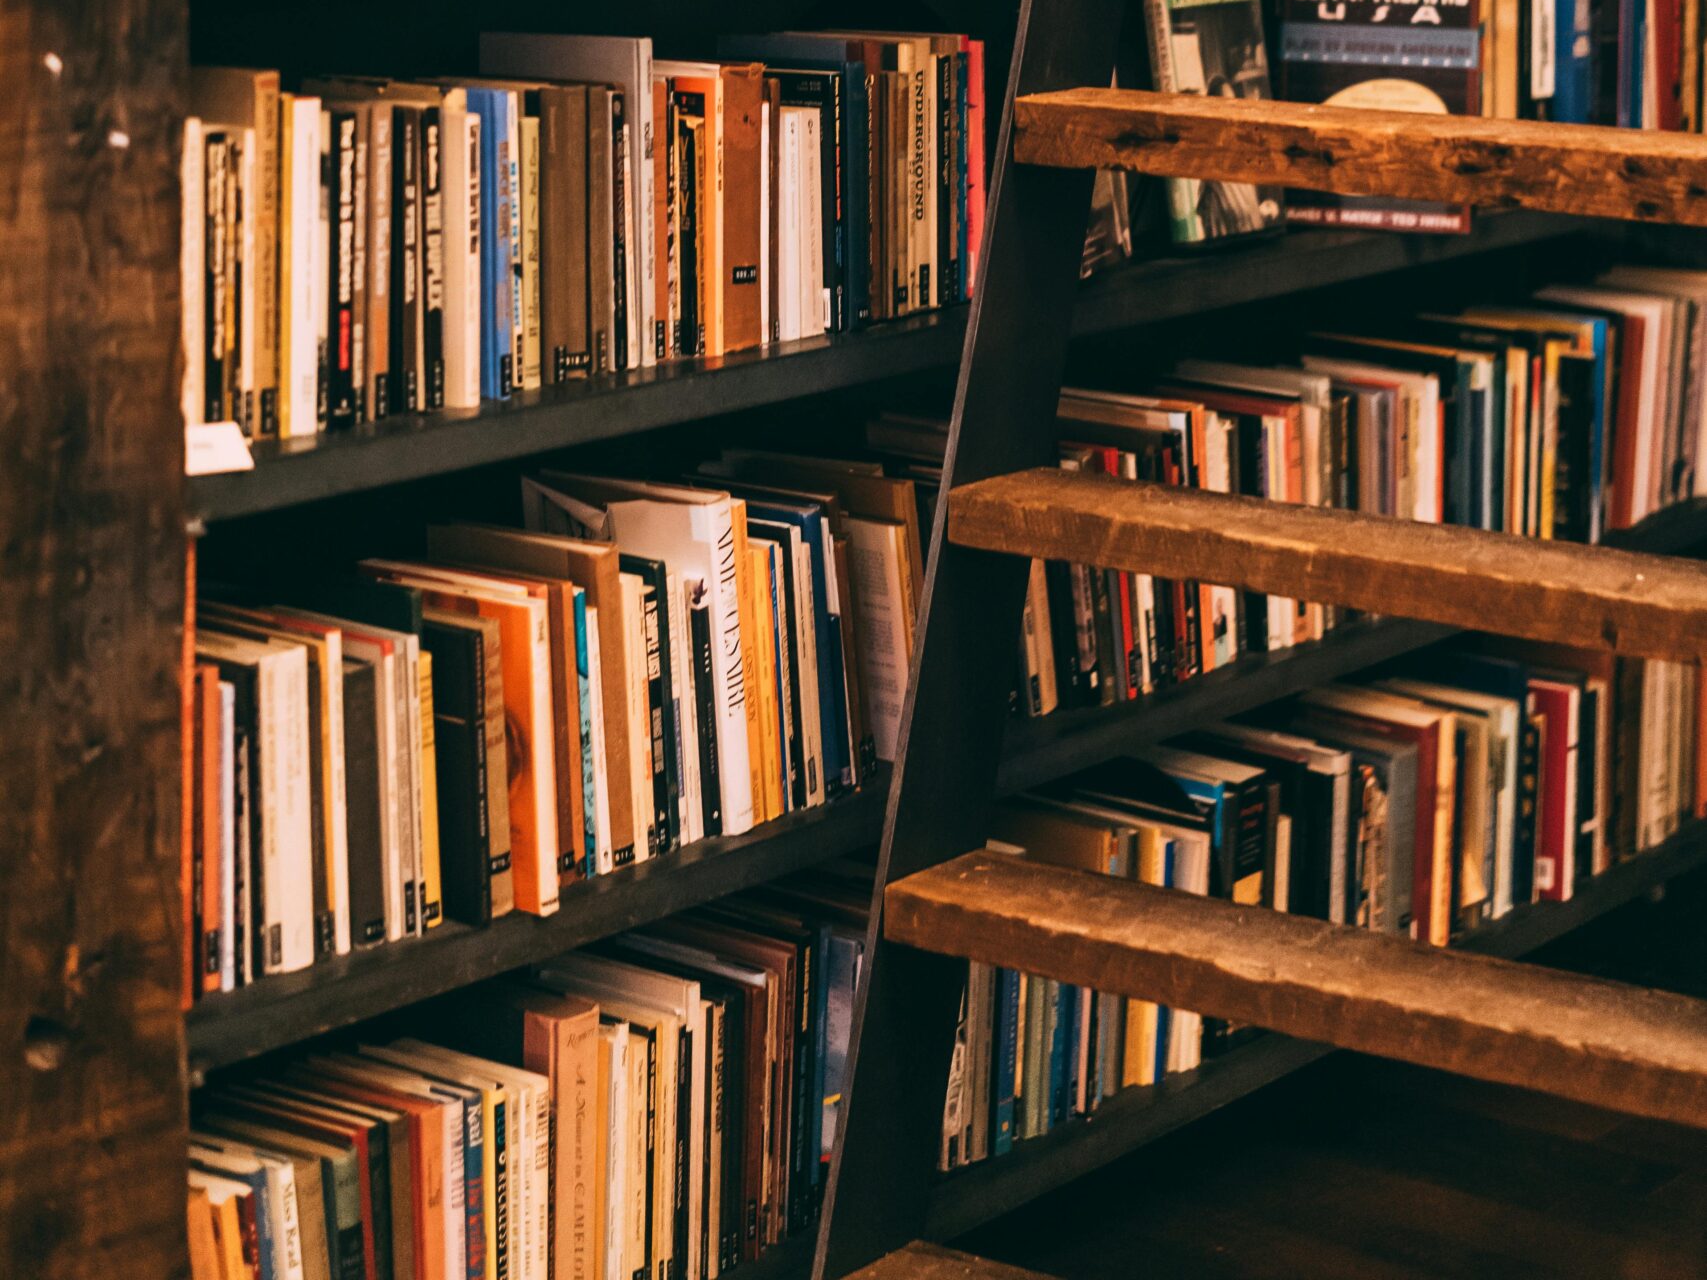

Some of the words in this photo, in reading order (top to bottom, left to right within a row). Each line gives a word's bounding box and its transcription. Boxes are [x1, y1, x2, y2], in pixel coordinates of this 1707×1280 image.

[942, 110, 950, 128] The
[913, 69, 925, 221] UNDERGROUND
[942, 130, 950, 156] River
[498, 139, 510, 196] BLACK
[940, 158, 950, 186] Niger
[425, 192, 442, 228] THE
[527, 228, 539, 263] Road
[427, 231, 443, 312] DUPLEX
[645, 601, 657, 610] A
[645, 610, 659, 652] SIMPLE
[647, 654, 661, 681] LUST
[744, 645, 754, 679] LOST
[746, 685, 757, 723] BODY
[575, 1063, 586, 1086] A
[574, 1090, 586, 1167] Moment
[281, 1181, 293, 1222] Miss
[285, 1227, 299, 1271] Read
